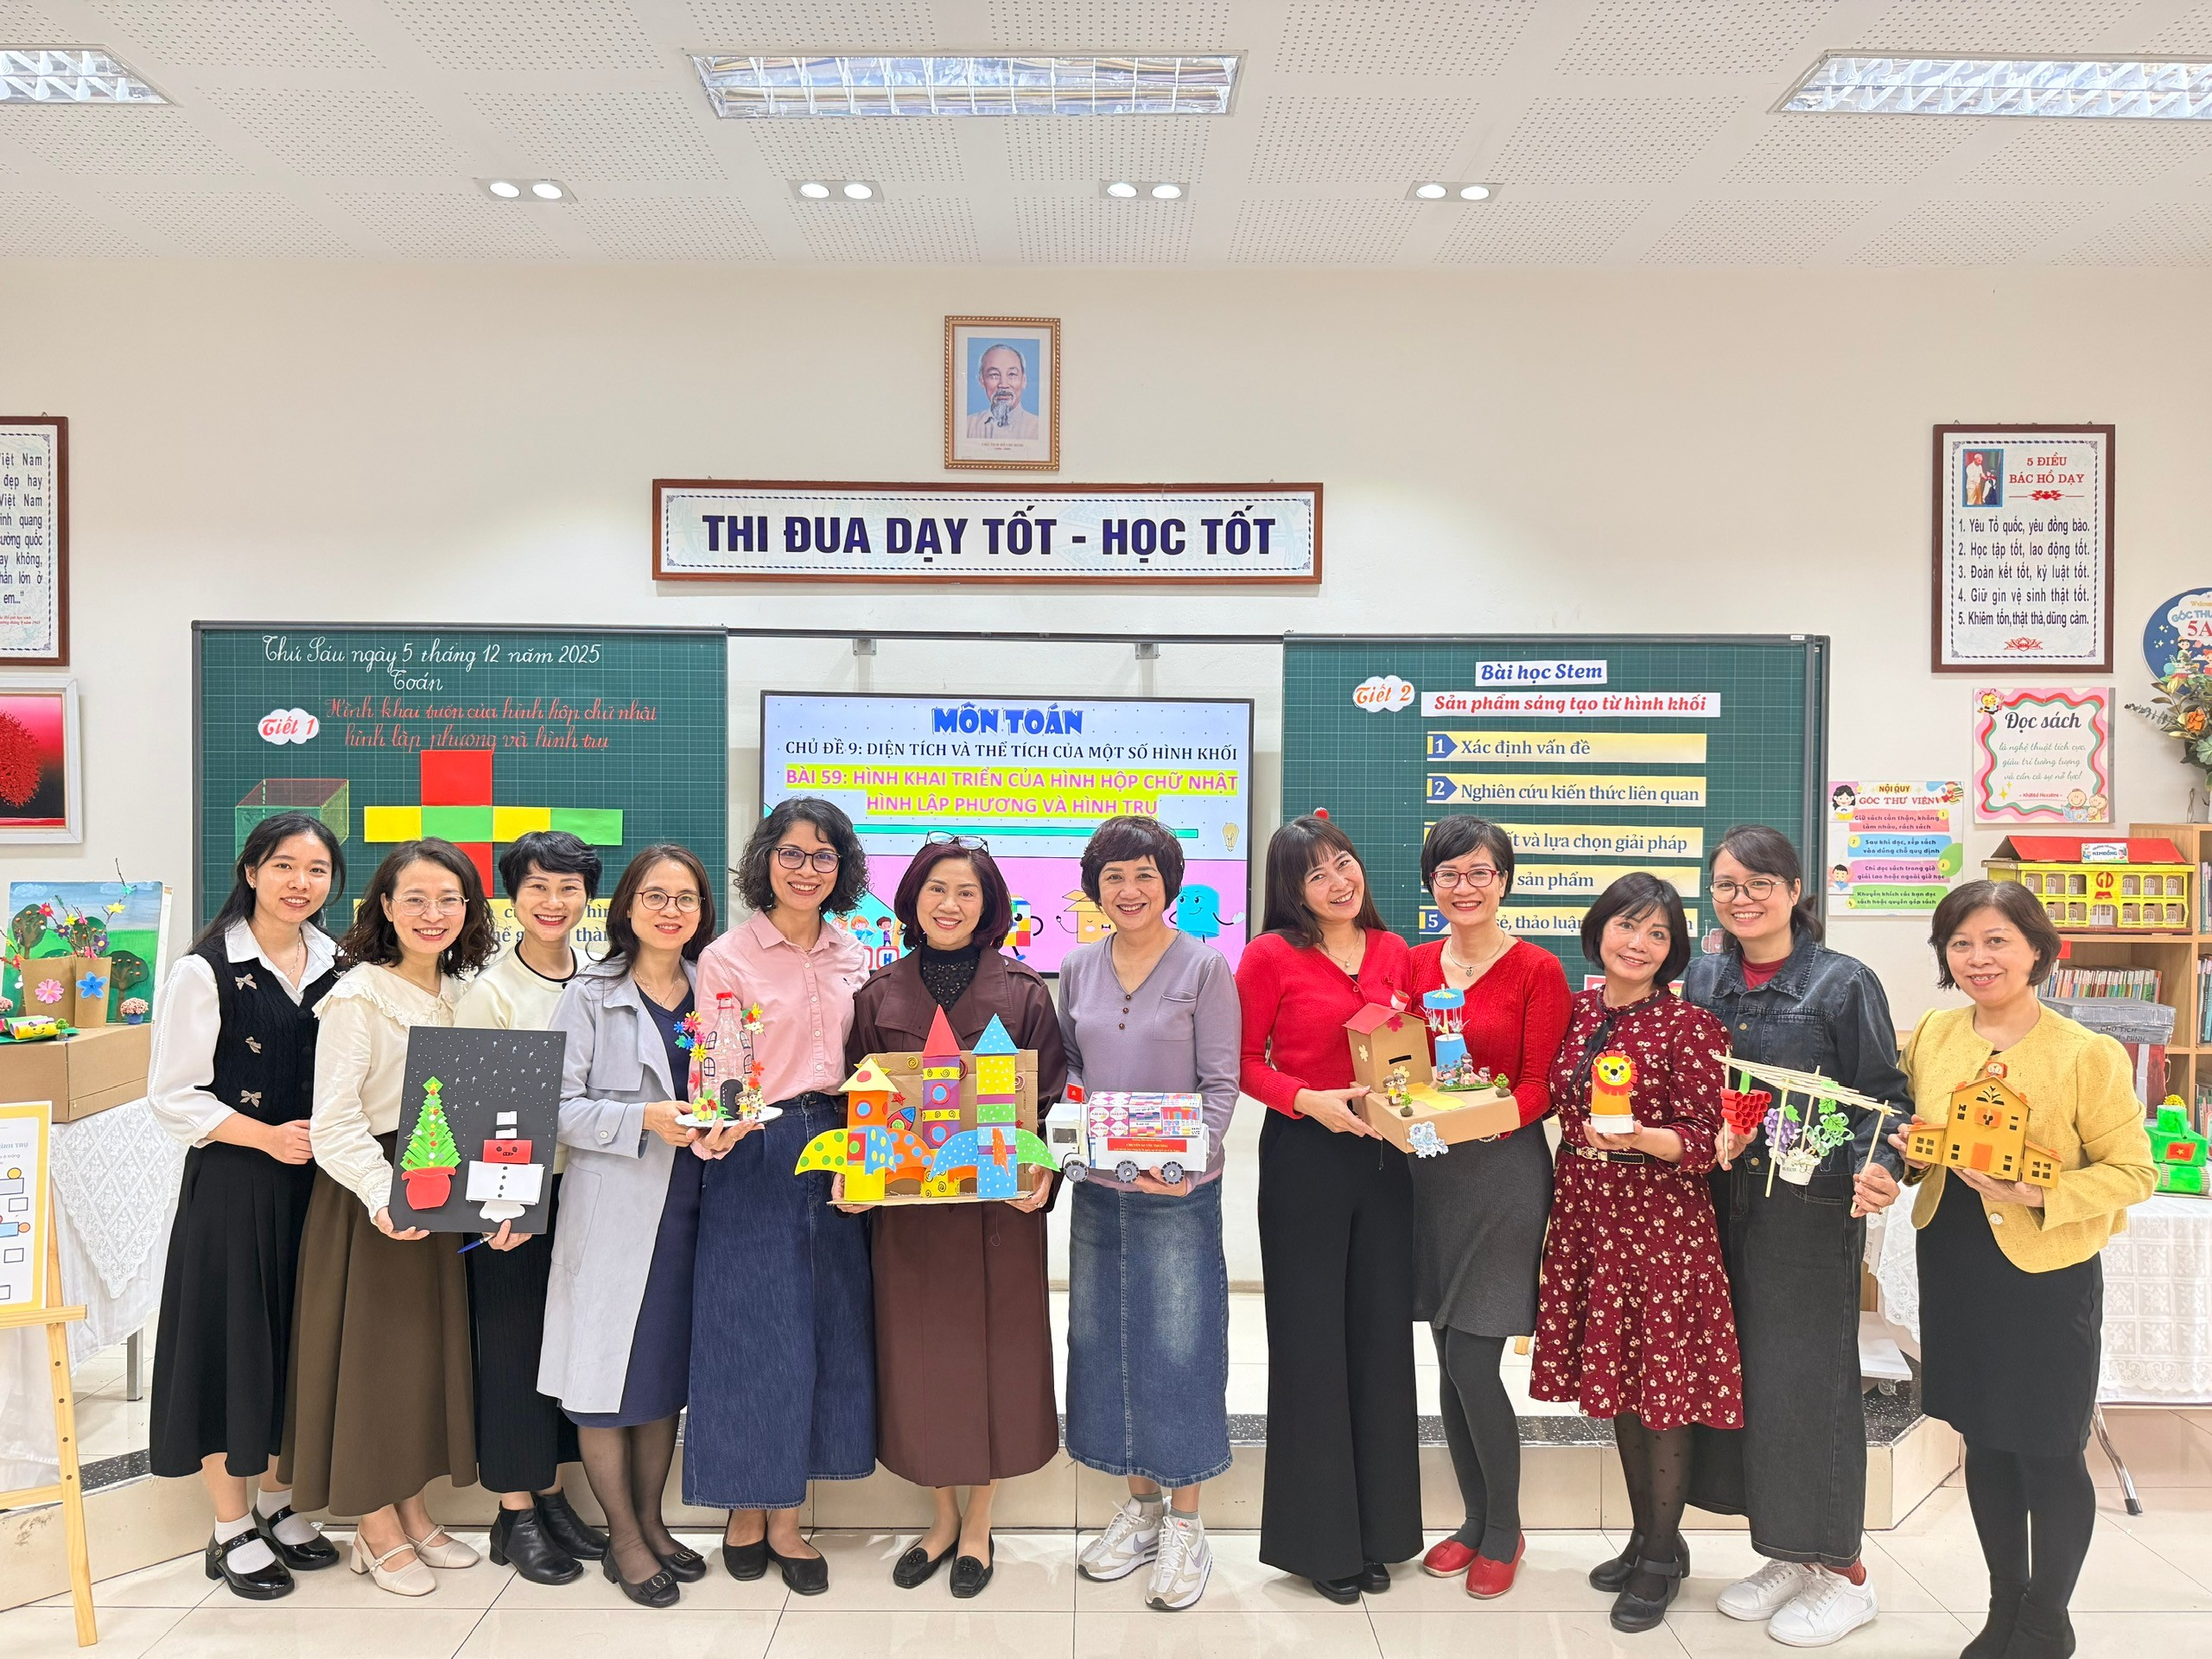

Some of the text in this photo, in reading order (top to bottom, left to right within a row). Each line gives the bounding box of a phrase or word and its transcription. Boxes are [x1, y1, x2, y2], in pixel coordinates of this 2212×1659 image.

[2037, 452, 2067, 466] ĐIỀU
[3, 474, 42, 490] đẹp hay
[2009, 469, 2084, 485] BÁC HỒ DẠY
[19, 516, 42, 529] quang
[1959, 515, 2089, 536] 1. Yêu Tổ quốc, yêu đồng bào.
[25, 530, 42, 549] quốc
[702, 515, 768, 552] THI
[784, 517, 872, 554] ĐUA
[886, 518, 969, 563] DẠY
[982, 505, 1057, 555] TỐT
[1103, 518, 1186, 563] HỌC
[1200, 505, 1275, 555] TỐT
[1959, 538, 2089, 559] 2. Học tập tốt, lao động tốt.
[1959, 565, 1966, 578] 3.
[1971, 565, 1993, 578] Đoàn
[1999, 562, 2012, 578] kết
[2018, 562, 2031, 581] tốt,
[2052, 565, 2069, 582] luật
[2075, 562, 2089, 578] tốt.
[1959, 584, 2089, 605] 4. Giữ gìn vệ sinh thật tốt.
[1959, 612, 1965, 625] 5.
[1968, 611, 1993, 625] Khiêm
[2070, 610, 2088, 624] cảm.
[307, 636, 346, 662] Sáu
[351, 646, 397, 672] ngày
[403, 642, 413, 662] 5
[421, 639, 476, 672] tháng
[483, 644, 500, 663] 12
[508, 648, 553, 663] năm
[558, 644, 601, 663] 2025
[390, 670, 443, 691] Toán
[1481, 664, 1602, 683] Bài học Stem
[1356, 683, 1411, 703] Tiết 2
[1434, 694, 1707, 714] Sản phẩm sáng tạo từ hình khối
[262, 716, 315, 735] Tiết 1
[931, 702, 1084, 736] MÔN TOÁN
[2005, 711, 2082, 734] Đọc sách
[786, 738, 1237, 761] CHỦ ĐỀ 9: DIỆN TÍCH VÀ THỂ TÍCH CỦA MỘT SỐ HÌNH KHỐI
[1435, 739, 1591, 757] 1 Xác định vấn đề
[786, 766, 1238, 793] BÀI 59: HÌNH KHAI TRIỂN CỦA HÌNH HỘP CHỮ NHẬT
[1434, 781, 1699, 804] 2 Nghiên cứu kiến thức liên quan
[868, 792, 911, 811] HÌNH
[918, 793, 950, 814] LẬP
[955, 798, 1037, 813] PHƯƠNG
[1043, 796, 1067, 813] VÀ
[1073, 796, 1117, 813] HÌNH
[1522, 834, 1540, 847] và
[1544, 834, 1569, 850] lựa
[1573, 835, 1611, 851] chọn
[1616, 834, 1643, 852] giải
[1648, 835, 1688, 853] pháp
[1517, 872, 1594, 891] sản phẩm
[1428, 913, 1548, 929] 5 thảo
